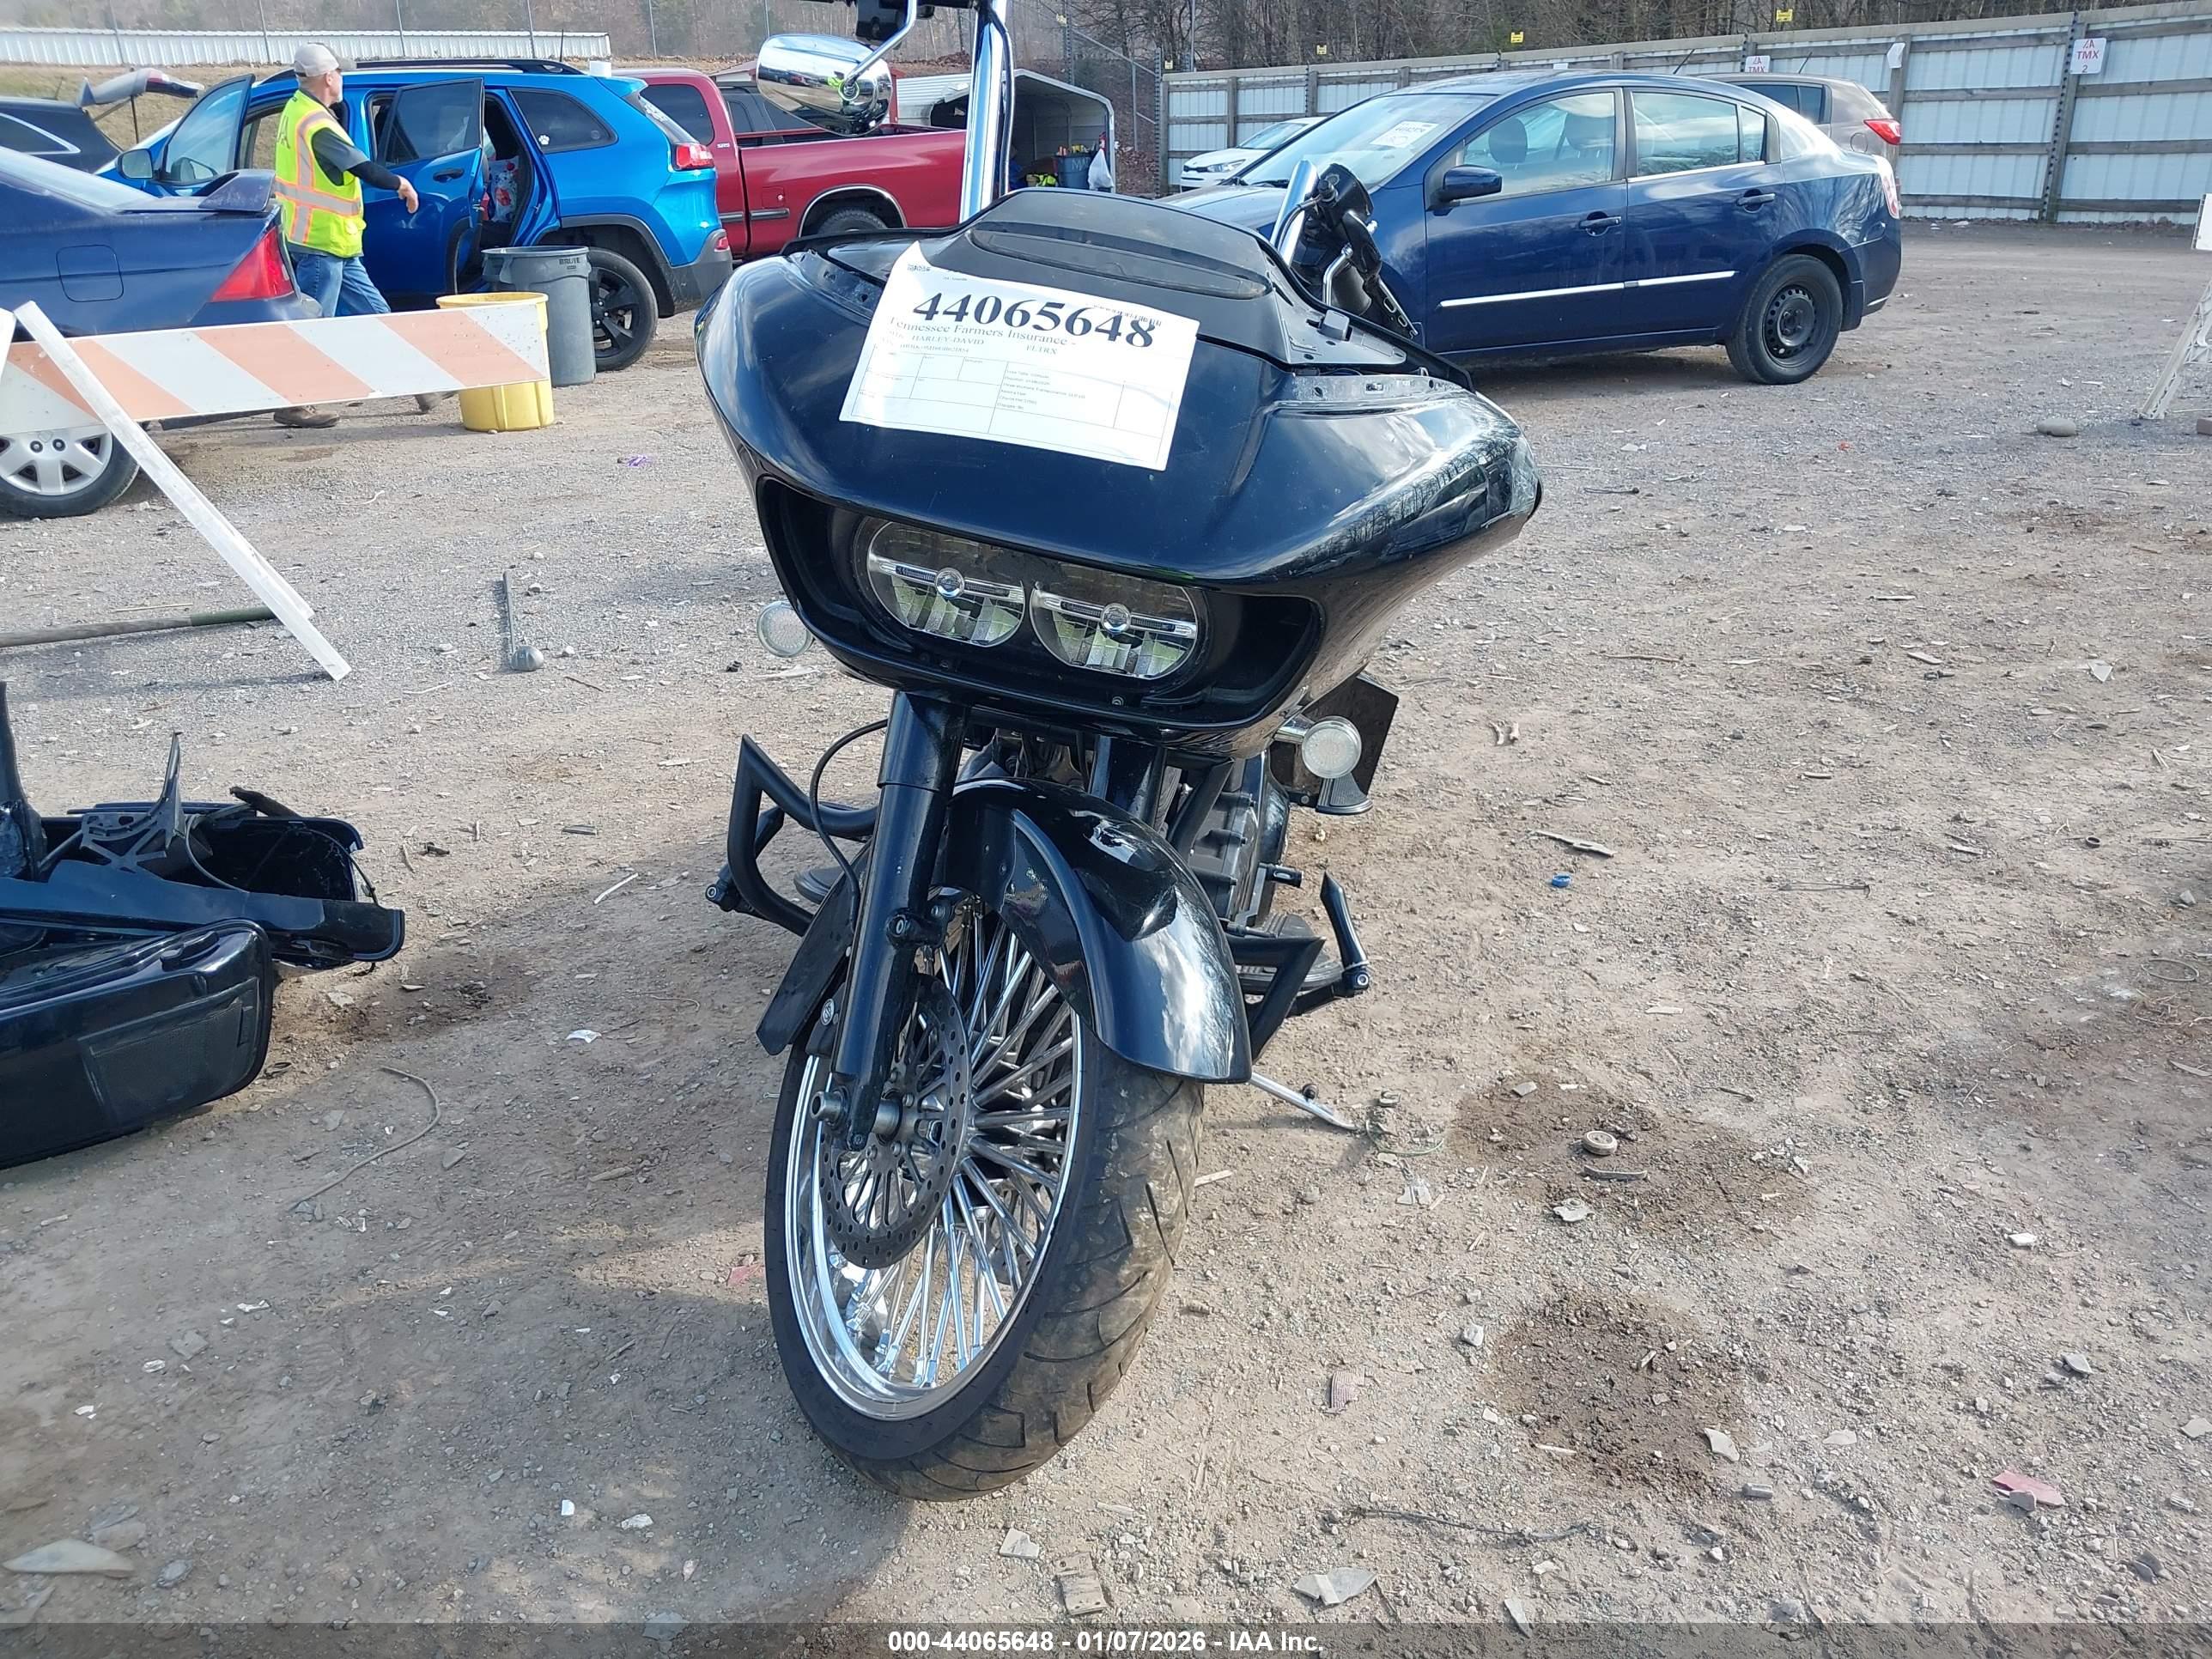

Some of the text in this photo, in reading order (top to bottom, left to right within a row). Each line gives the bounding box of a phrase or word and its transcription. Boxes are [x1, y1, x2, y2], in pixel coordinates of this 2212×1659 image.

[2075, 50, 2100, 60] TMX
[2081, 64, 2088, 73] 2
[913, 293, 1156, 348] 44065648
[890, 316, 951, 333] Tennessee
[954, 324, 1004, 337] Farmers
[1007, 329, 1068, 345] Insurance
